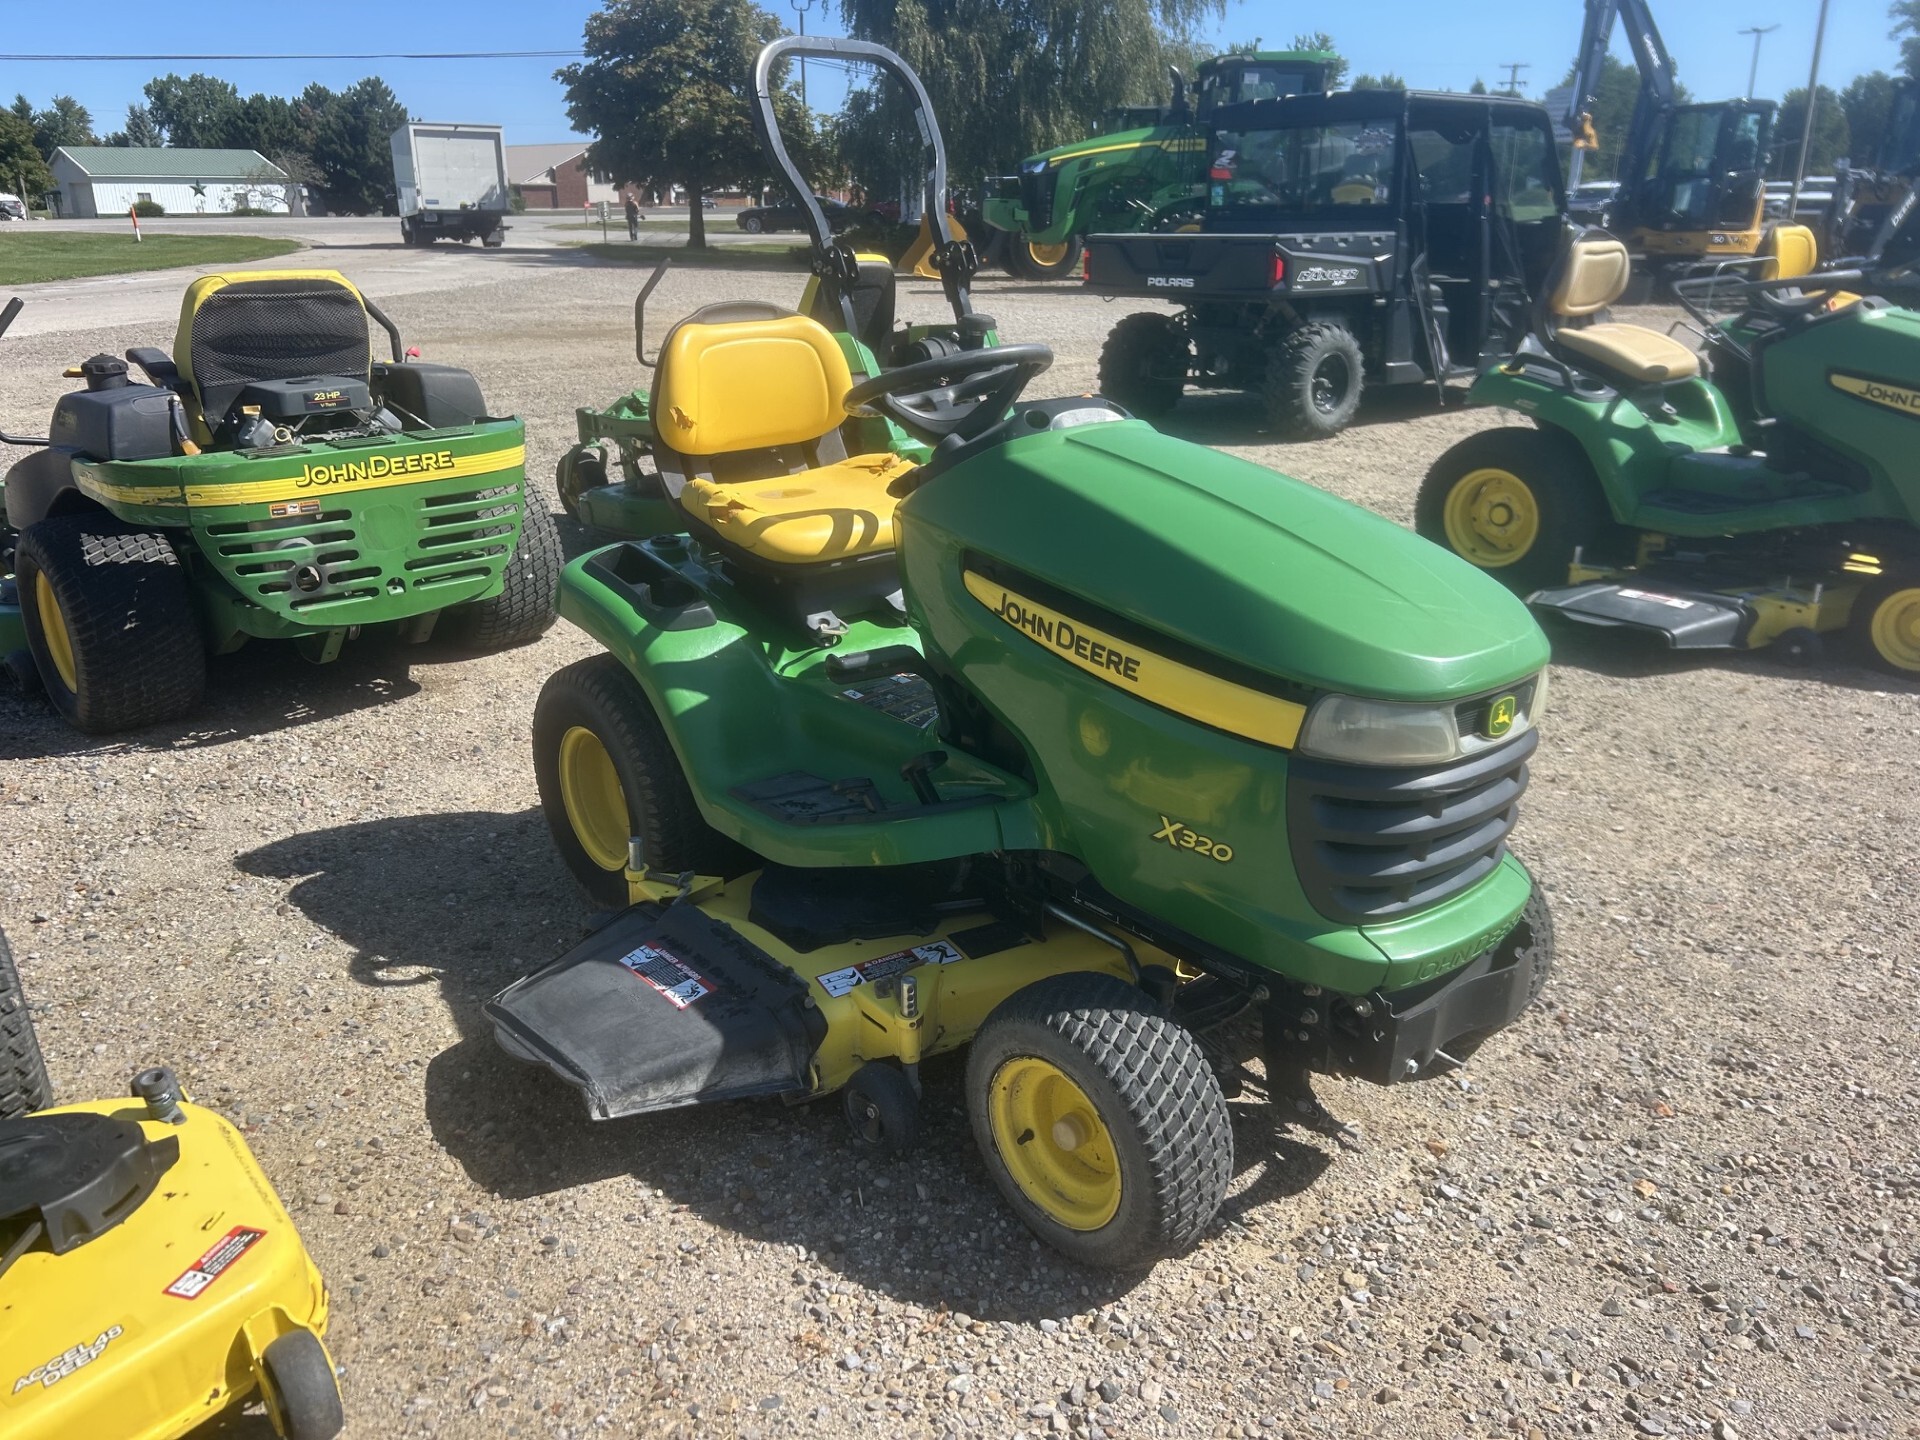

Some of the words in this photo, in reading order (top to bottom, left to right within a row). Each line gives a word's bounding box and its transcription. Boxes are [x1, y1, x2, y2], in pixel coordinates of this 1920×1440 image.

[1147, 276, 1195, 288] POLARIS
[1296, 267, 1360, 282] RANGER
[314, 392, 326, 401] 23
[326, 391, 341, 399] HP
[1858, 383, 1910, 406] JOHN
[296, 461, 369, 488] JOHN
[368, 449, 455, 478] DEERE
[994, 592, 1054, 643] JOHN
[1055, 620, 1141, 683] DEERE
[1151, 813, 1234, 863] X320
[871, 951, 905, 966] DANGER
[1401, 945, 1472, 987] JOHN
[11, 1341, 95, 1396] ACCEL
[93, 1323, 125, 1349] 48
[41, 1338, 109, 1389] DEEP
